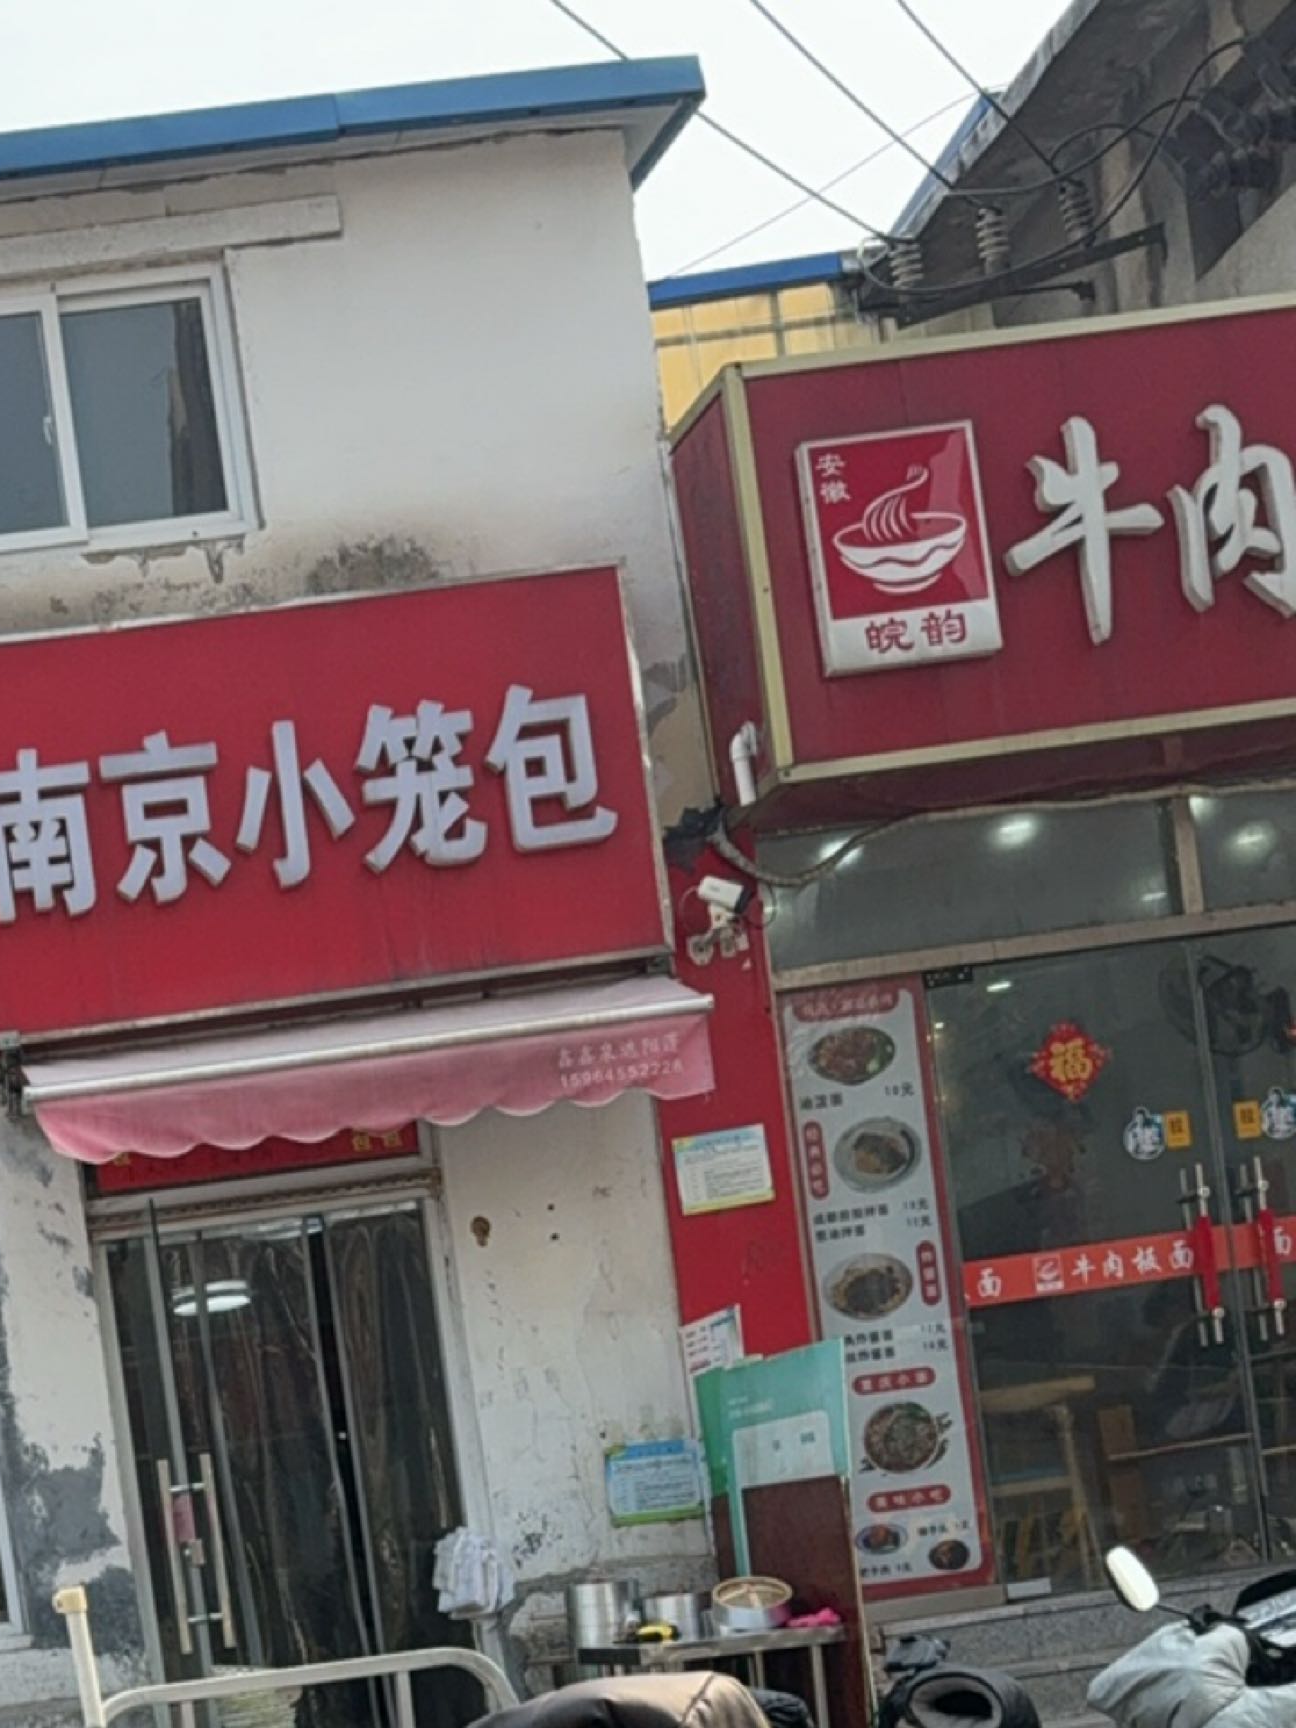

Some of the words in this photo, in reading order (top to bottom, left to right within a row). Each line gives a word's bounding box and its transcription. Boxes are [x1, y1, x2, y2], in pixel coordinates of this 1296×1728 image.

[1005, 403, 1296, 647] 牛肉
[864, 608, 968, 654] 皖韵
[1071, 1239, 1194, 1284] 牛肉板面
